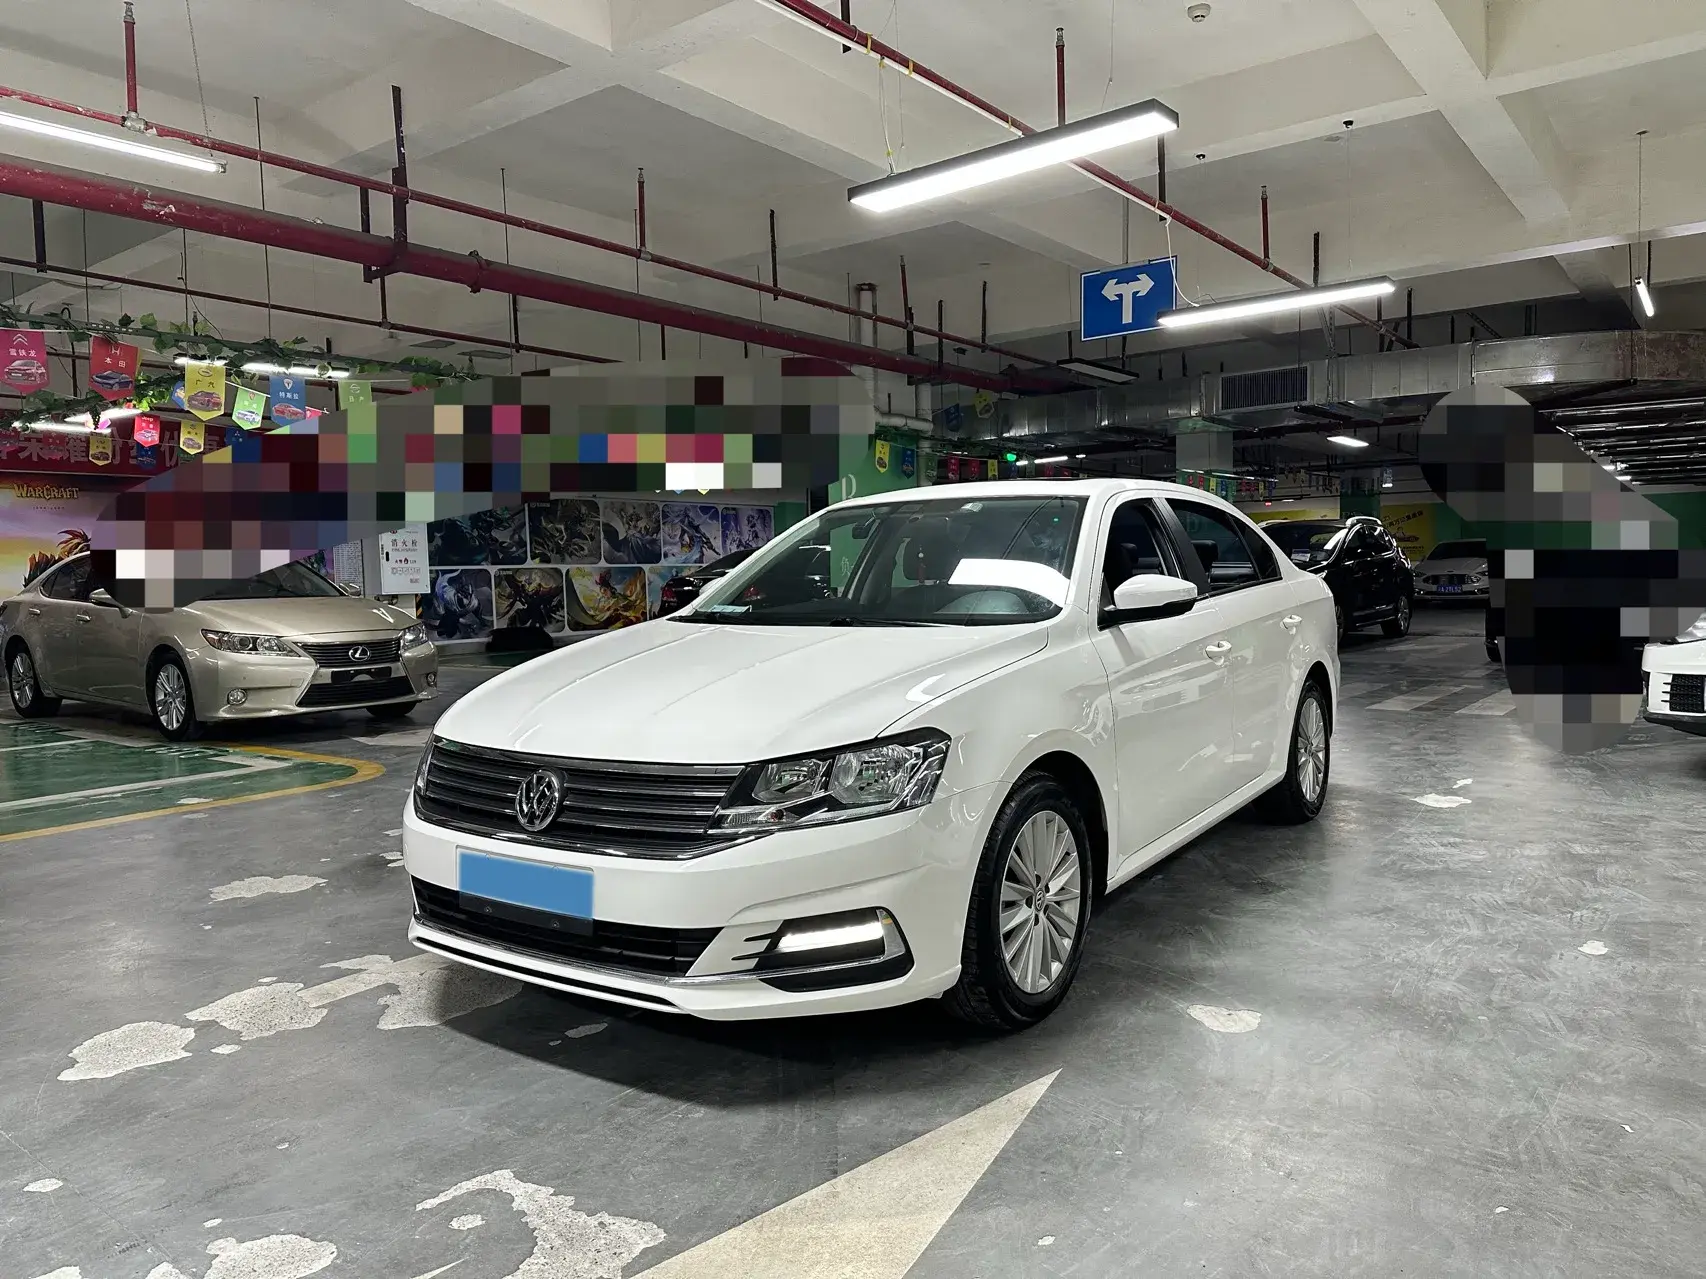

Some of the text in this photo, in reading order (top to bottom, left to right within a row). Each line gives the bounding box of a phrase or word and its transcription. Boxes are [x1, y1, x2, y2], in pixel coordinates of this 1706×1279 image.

[104, 357, 126, 369] 本田
[279, 391, 300, 400] 特斯拉
[391, 538, 418, 548] 消火栓
